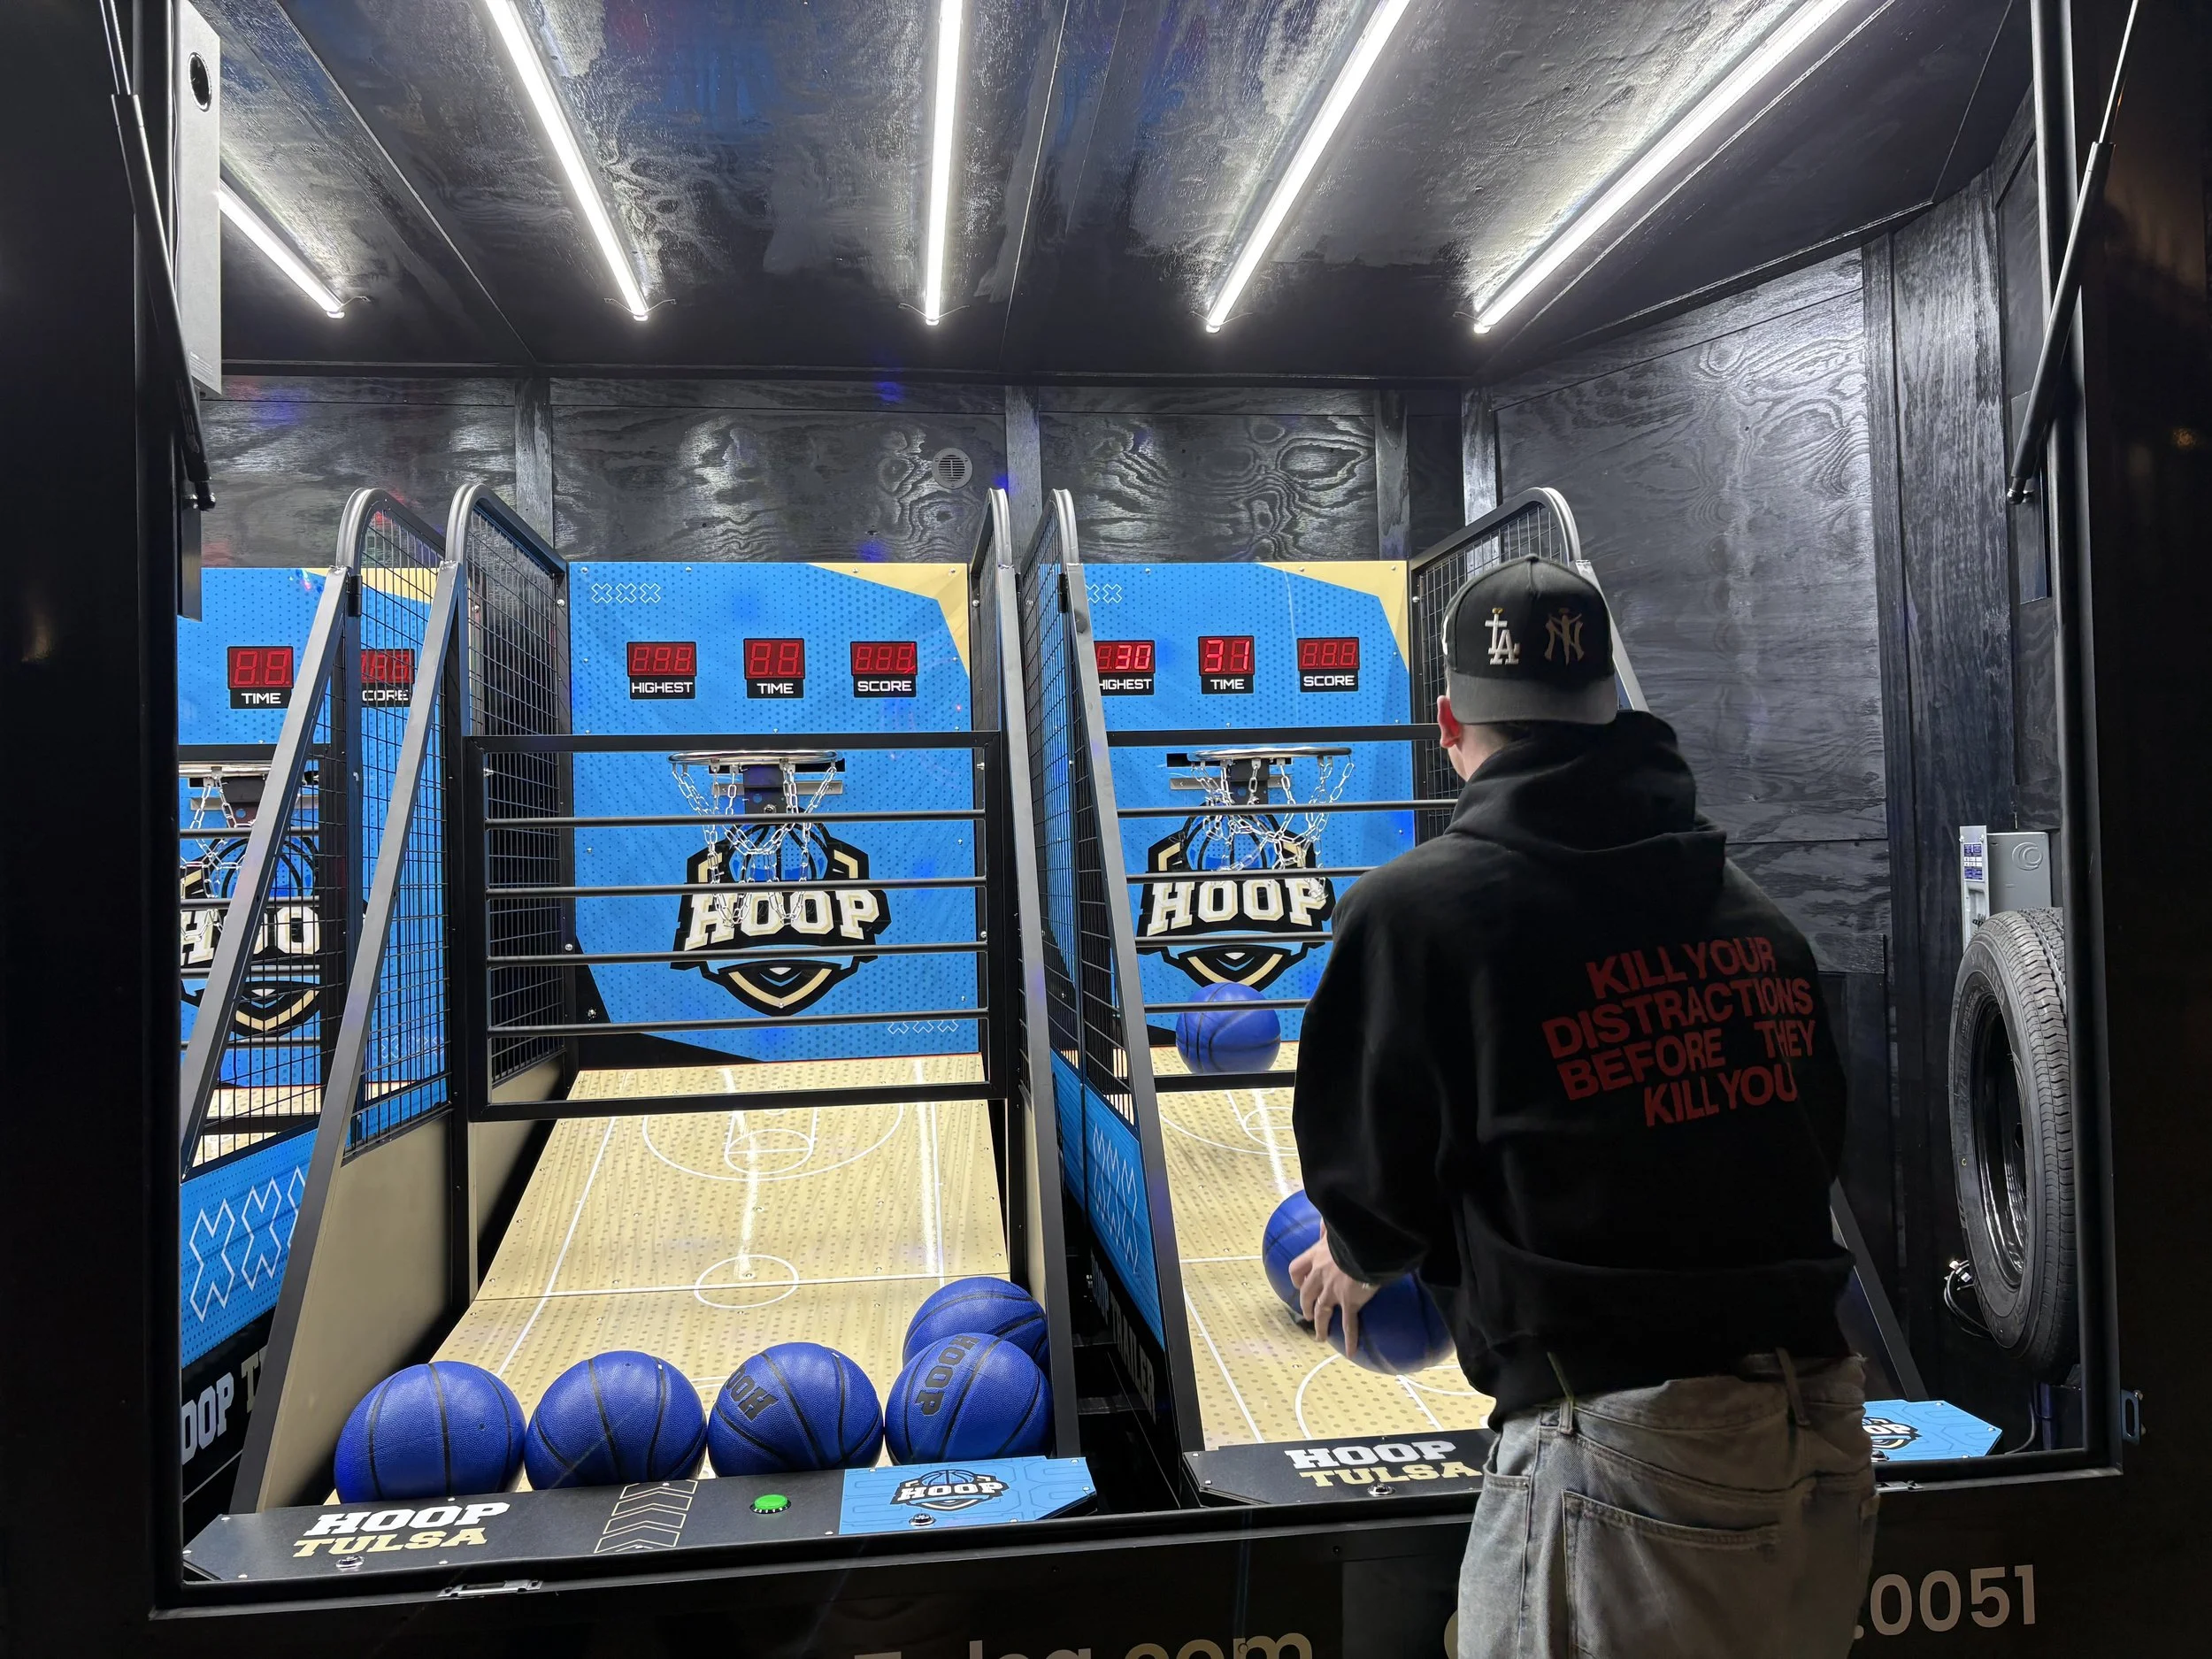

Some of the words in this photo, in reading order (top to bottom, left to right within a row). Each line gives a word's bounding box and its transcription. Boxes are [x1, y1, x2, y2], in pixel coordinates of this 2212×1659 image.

[1485, 608, 1520, 664] LA
[1544, 608, 1585, 664] NY
[362, 689, 409, 702] CORE
[631, 681, 694, 695] HIGHEST
[757, 682, 795, 695] TIME
[856, 680, 912, 692] SCORE
[1210, 679, 1245, 690] TIME
[1302, 674, 1356, 687] SCORE
[241, 692, 281, 704] TIME
[684, 889, 880, 951] HOOP
[1147, 877, 1327, 937] HOOP
[1586, 946, 1687, 1000] KILL
[1682, 936, 1777, 980] YOUR
[1542, 977, 1815, 1060] DISTRACTIONS
[1557, 1028, 1726, 1101] BEFORE
[1754, 1019, 1816, 1058] THEY
[1644, 1076, 1720, 1127] KILL
[1718, 1063, 1798, 1110] YOU
[915, 1334, 981, 1416] HOOP
[181, 1371, 234, 1466] OOP
[1284, 1440, 1457, 1470] HOOP
[1299, 1461, 1484, 1488] TULSA
[896, 1481, 1003, 1502] HOOP
[303, 1502, 511, 1537] HOOP
[293, 1527, 488, 1558] TULSA
